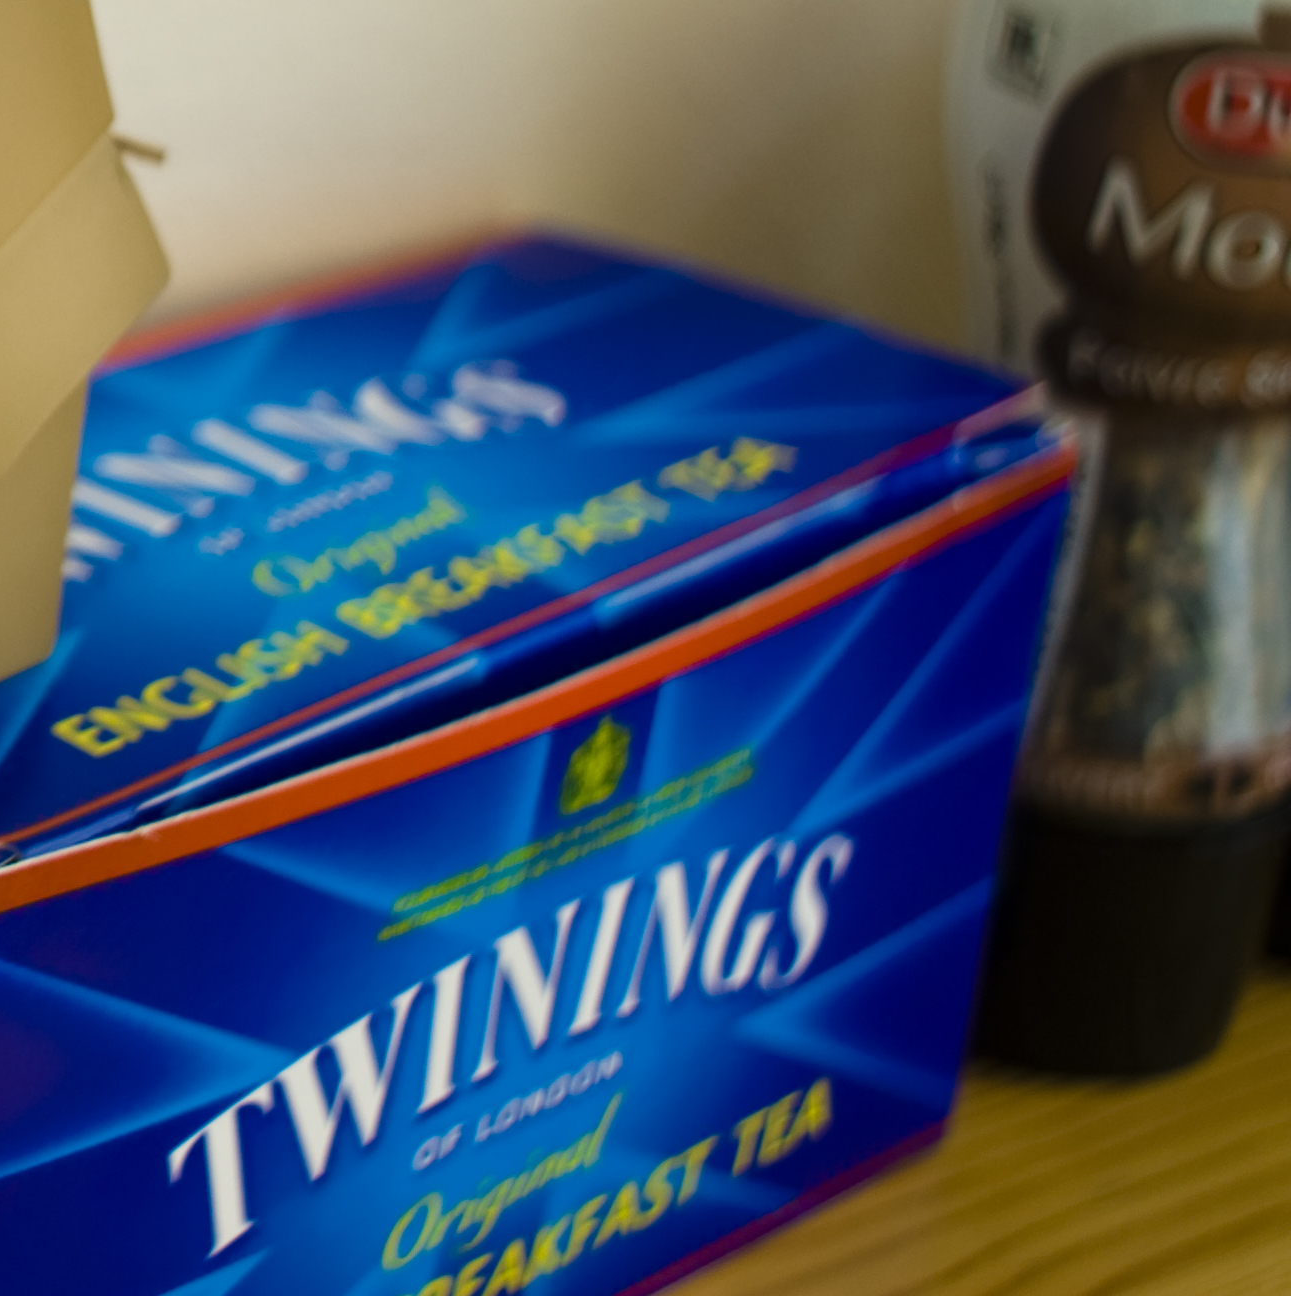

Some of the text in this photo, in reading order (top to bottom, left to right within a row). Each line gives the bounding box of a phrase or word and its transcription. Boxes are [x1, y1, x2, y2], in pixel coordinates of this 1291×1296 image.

[1084, 154, 1291, 291] Mo
[51, 620, 349, 758] ENGLISH
[168, 832, 853, 1260] TWININGS
[412, 1051, 623, 1172] OF LONDON
[381, 1091, 623, 1270] Original
[732, 1076, 834, 1178] TEA
